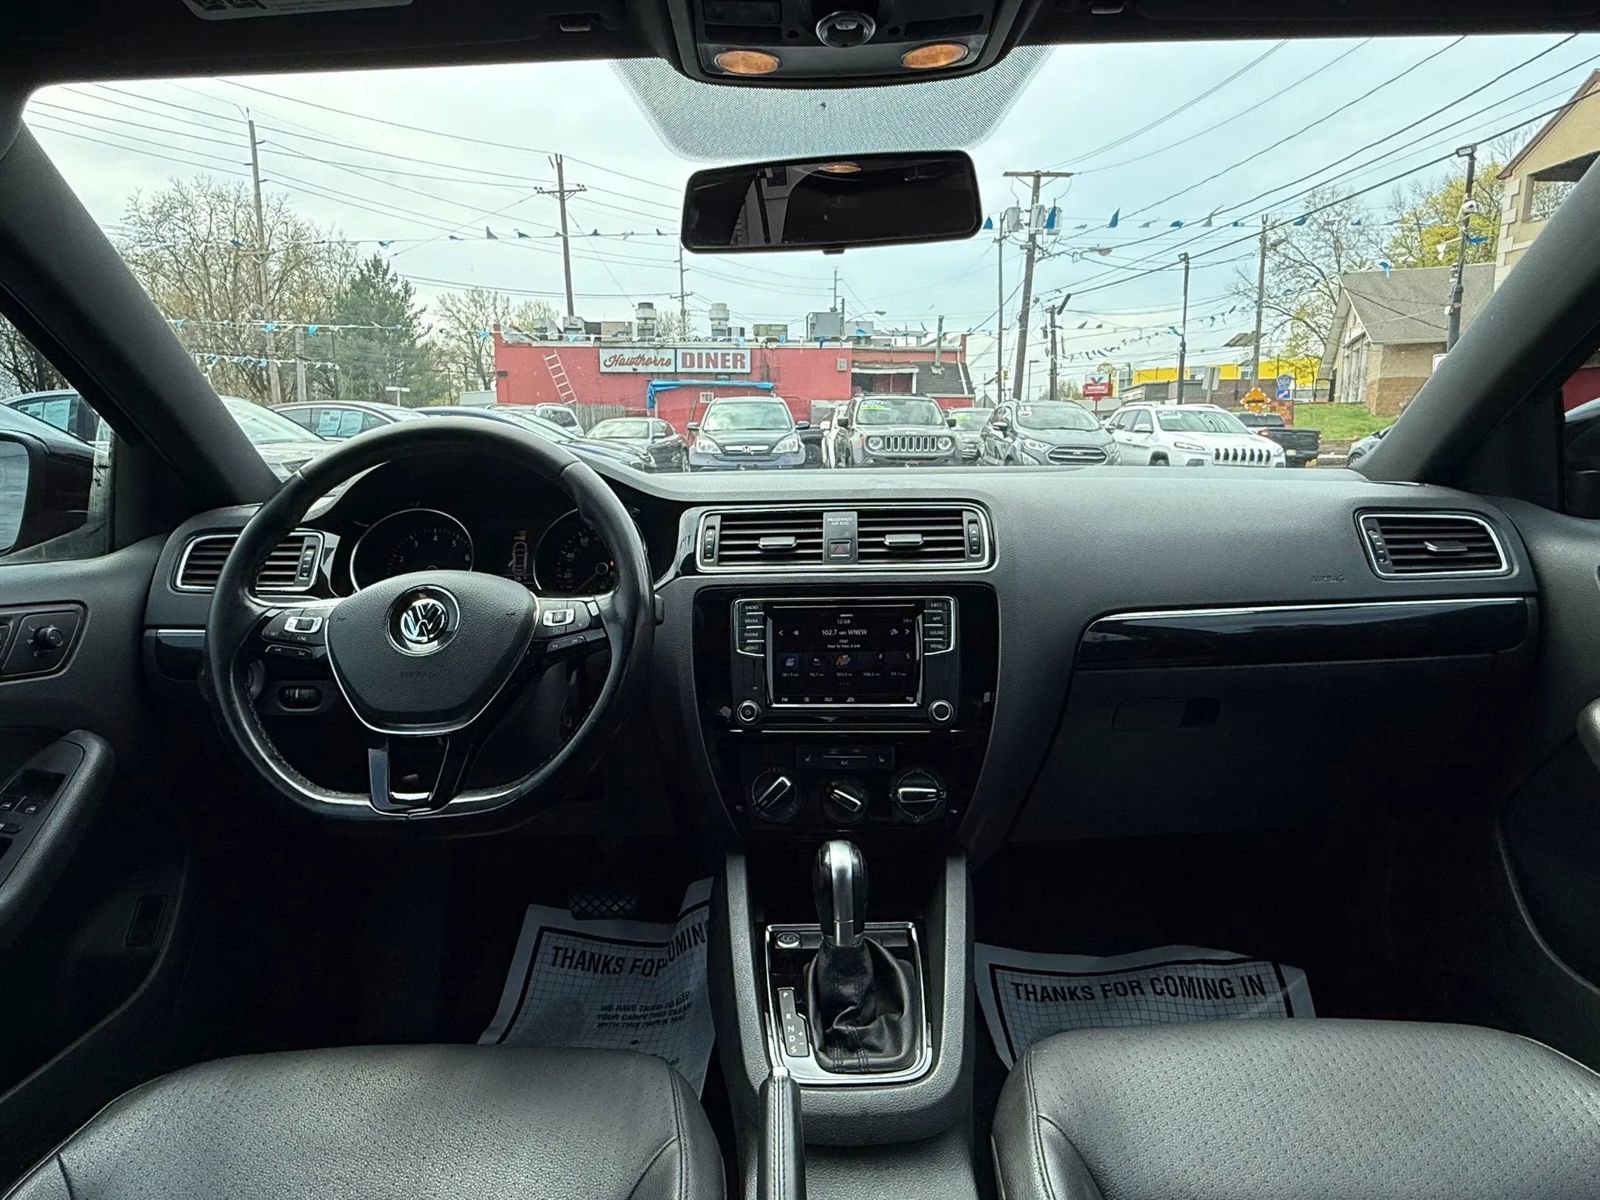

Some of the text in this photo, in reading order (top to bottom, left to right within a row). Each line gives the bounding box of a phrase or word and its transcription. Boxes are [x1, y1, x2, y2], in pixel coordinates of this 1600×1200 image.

[603, 352, 746, 369] Hawthorne DINER
[551, 946, 625, 975] THANKS
[1010, 973, 1267, 1003] THANKS FOR COMING IN
[601, 1003, 613, 1012] WE
[615, 1003, 637, 1012] HAVE
[785, 1012, 792, 1021] R
[597, 1021, 620, 1029] WITH
[787, 1024, 795, 1033] N
[789, 1035, 796, 1043] D
[790, 1046, 797, 1054] S
